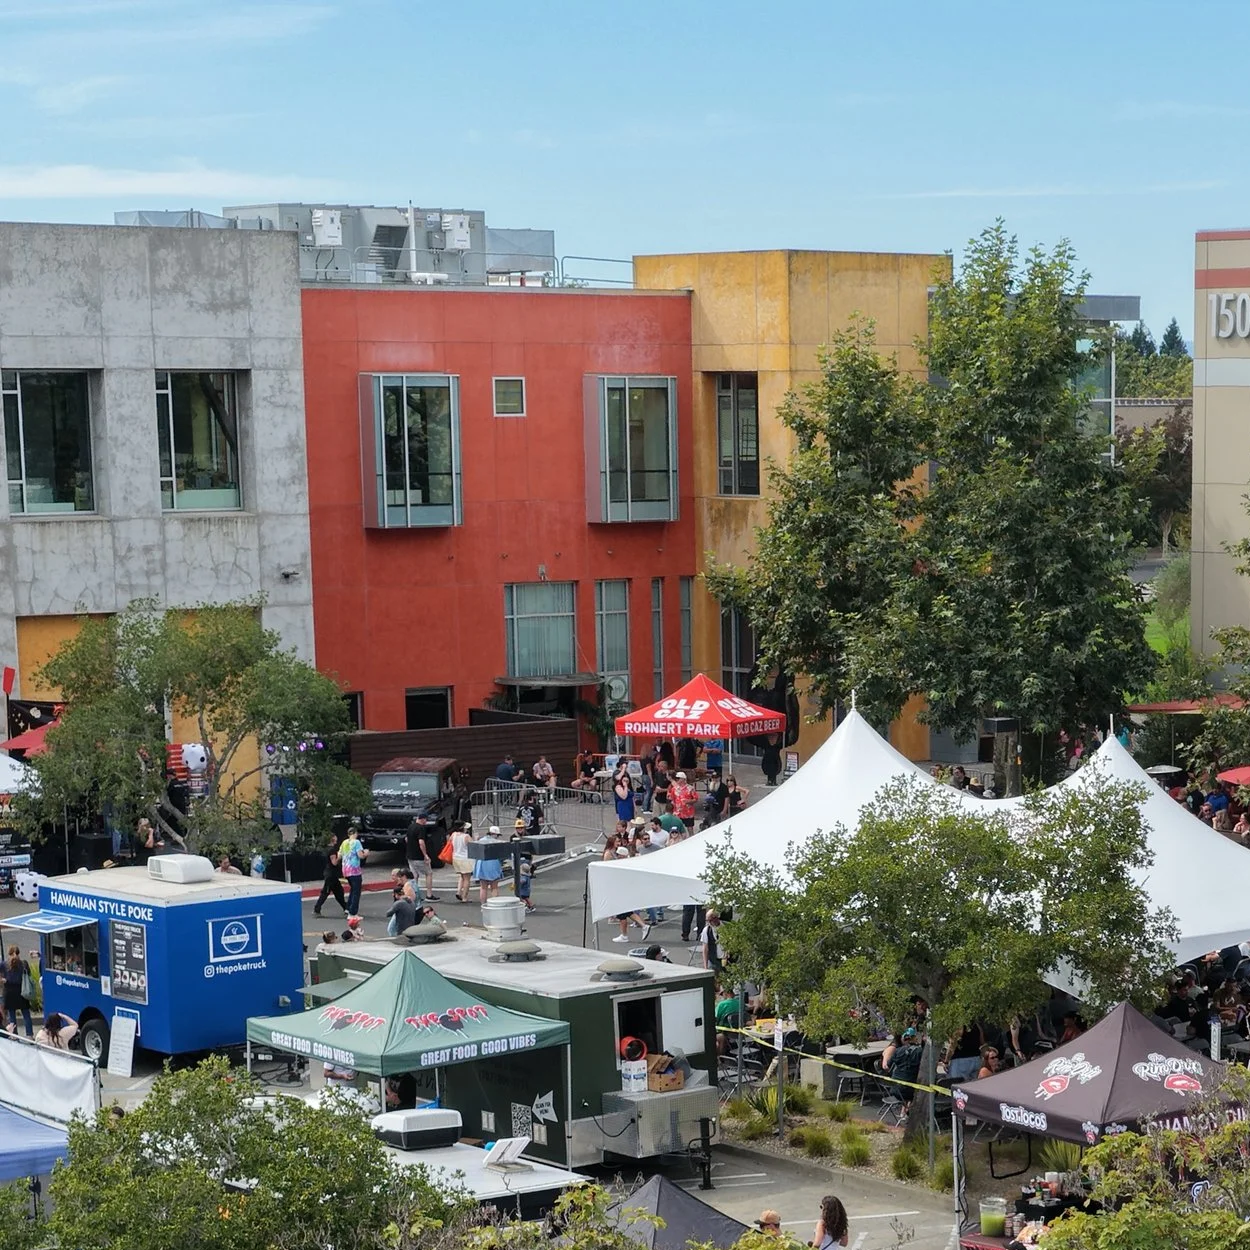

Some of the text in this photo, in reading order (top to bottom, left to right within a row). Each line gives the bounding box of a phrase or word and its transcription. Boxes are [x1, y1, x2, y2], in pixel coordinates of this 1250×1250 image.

[661, 698, 710, 711] OLD
[717, 697, 748, 710] OLD
[654, 709, 704, 720] CAZ
[730, 706, 764, 719] CAZ
[625, 722, 720, 736] ROHNERT PARK
[736, 718, 780, 735] OLD CAZ BEER
[51, 892, 153, 921] HAWAIIAN STYLE POKE
[216, 959, 267, 975] thepoketruck
[346, 1011, 387, 1033] SPOT
[446, 1004, 490, 1025] SPOT
[271, 1031, 354, 1066] GREAT FOOD GOOD VIBES
[421, 1034, 536, 1066] GREAT FOOD GOOD VIBES
